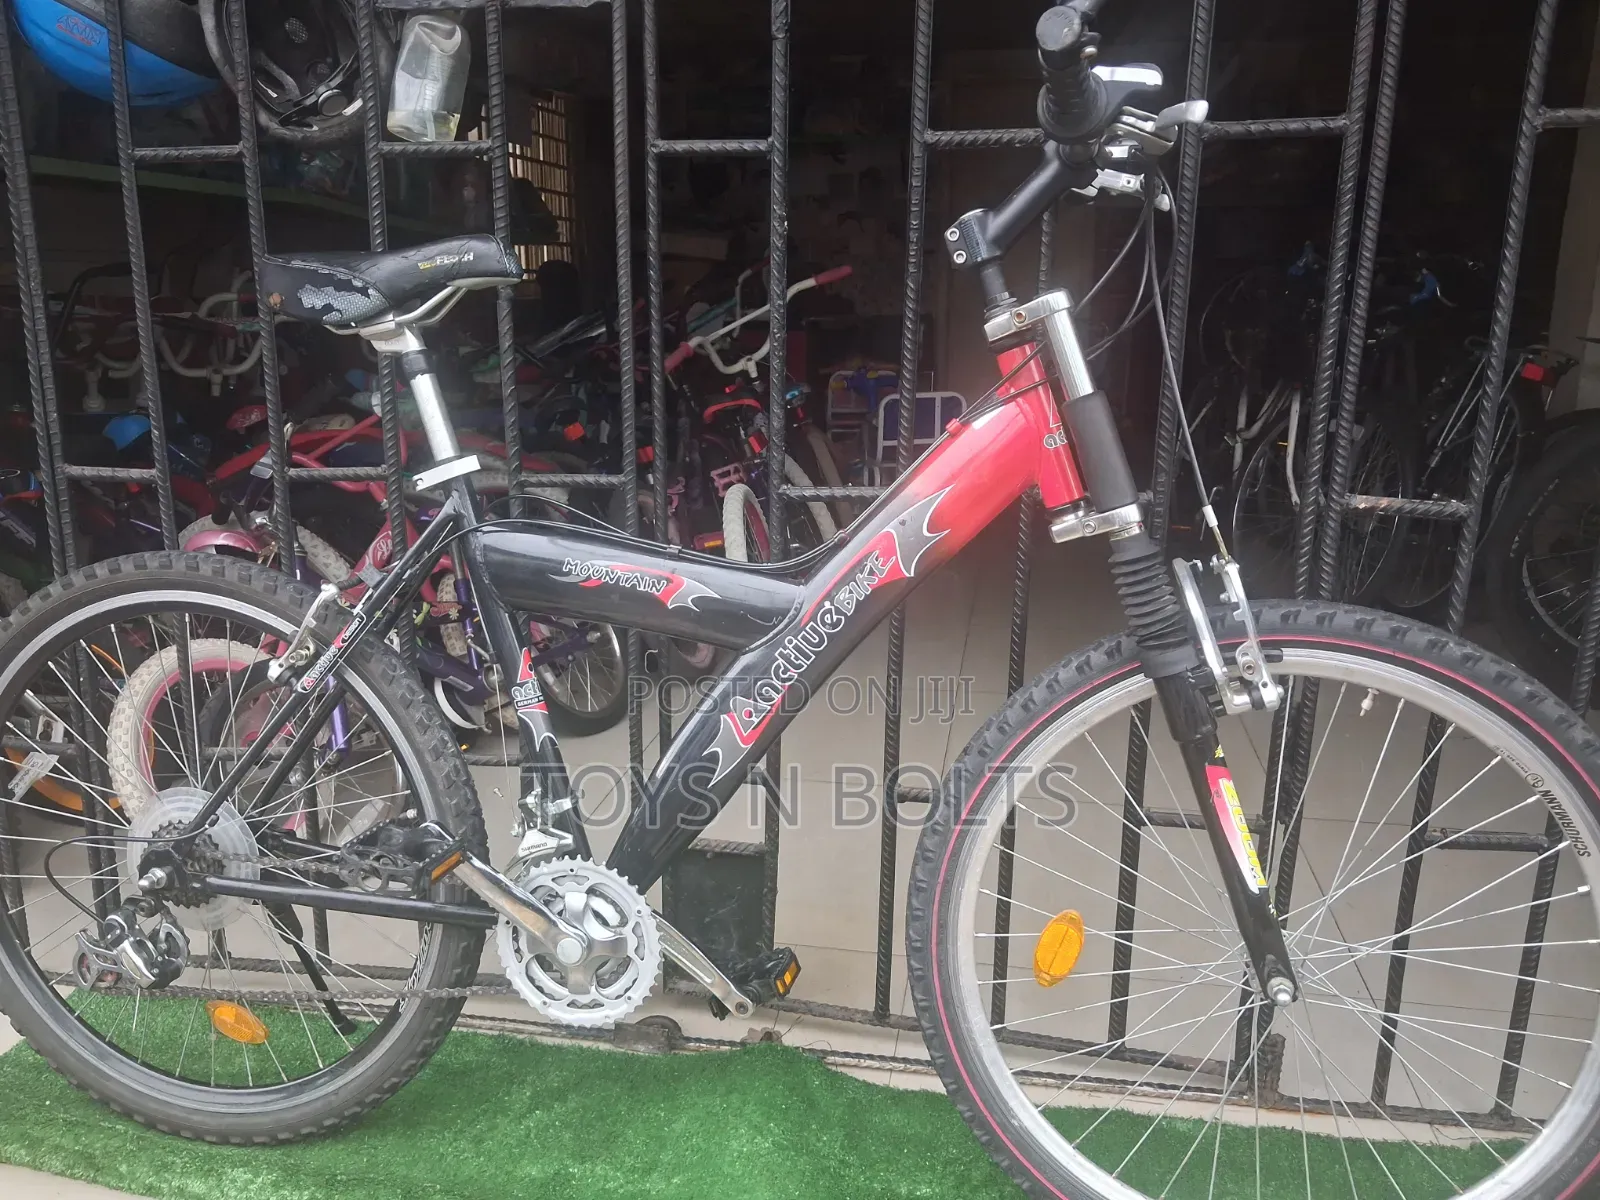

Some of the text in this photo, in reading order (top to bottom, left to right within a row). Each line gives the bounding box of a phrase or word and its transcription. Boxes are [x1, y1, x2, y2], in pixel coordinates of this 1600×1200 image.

[562, 557, 668, 595] MOUNTAIN
[834, 550, 897, 617] BIKE
[1219, 778, 1268, 887] ZOOM
